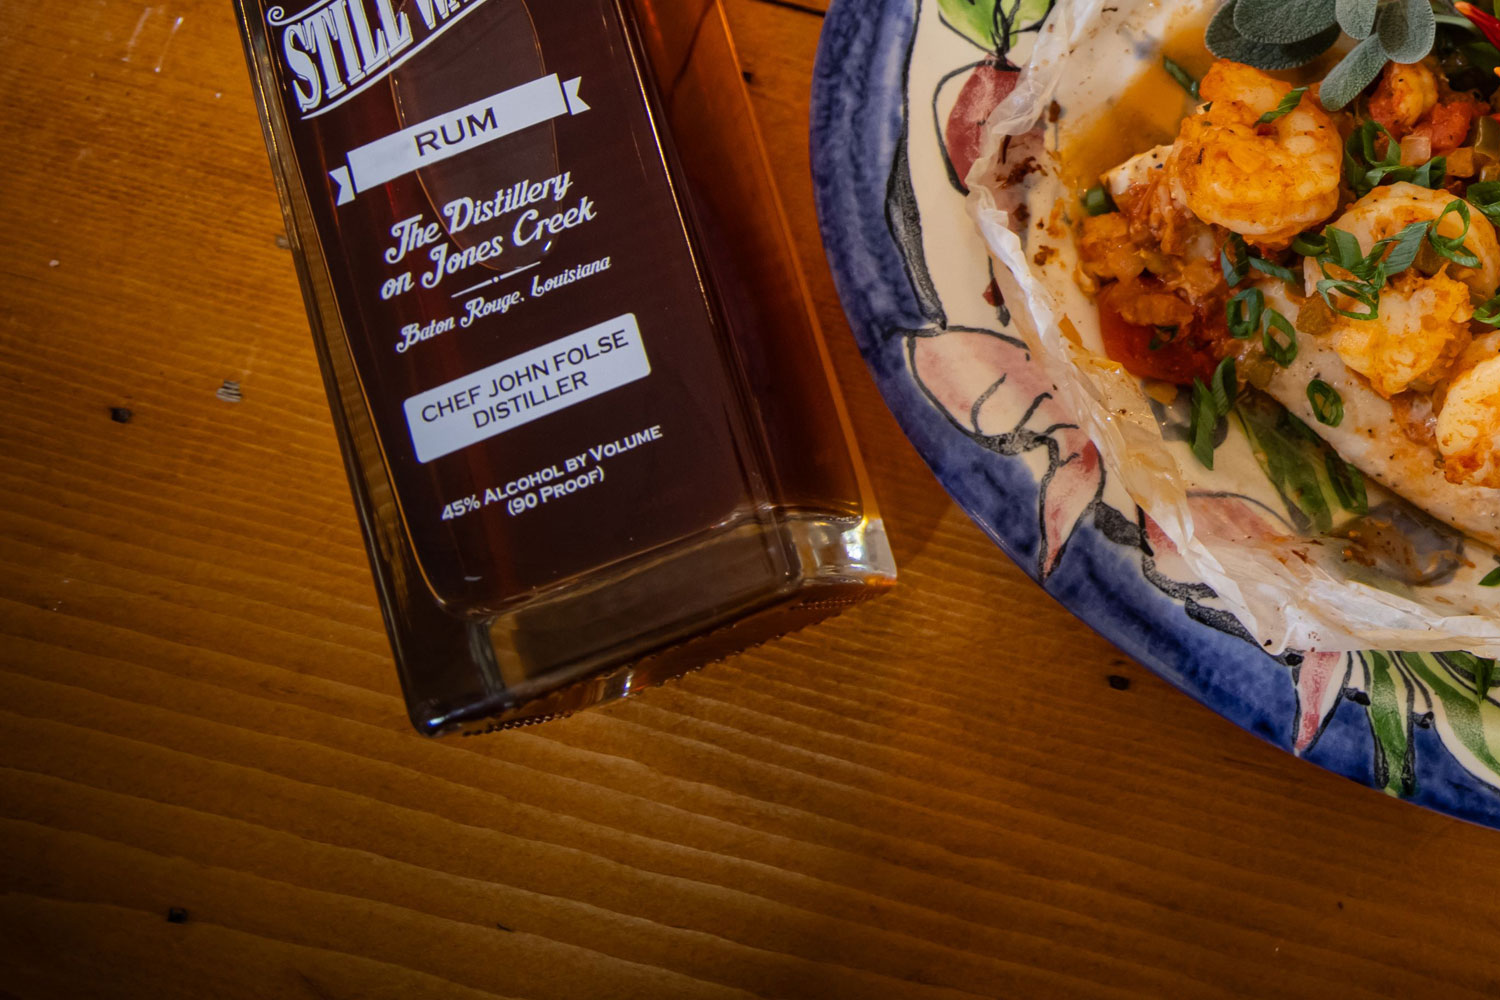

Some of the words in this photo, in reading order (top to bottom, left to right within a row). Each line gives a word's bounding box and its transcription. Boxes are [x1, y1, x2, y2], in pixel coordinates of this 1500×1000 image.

[414, 107, 498, 157] RUM
[380, 269, 414, 299] on
[421, 242, 503, 288] Jones
[512, 195, 598, 246] Creek
[385, 214, 441, 263] The
[443, 171, 572, 235] Distillery
[396, 316, 455, 353] Baton
[531, 256, 611, 297] Louisiana
[421, 386, 483, 423] CHEF
[488, 362, 549, 398] JOHN
[553, 329, 629, 371] FOLSE
[472, 370, 589, 428] DISTILLER
[441, 494, 481, 520] 45%
[483, 464, 564, 504] ALCOHOL
[565, 453, 588, 472] BY
[589, 425, 663, 462] VOLUME
[506, 493, 538, 516] (90
